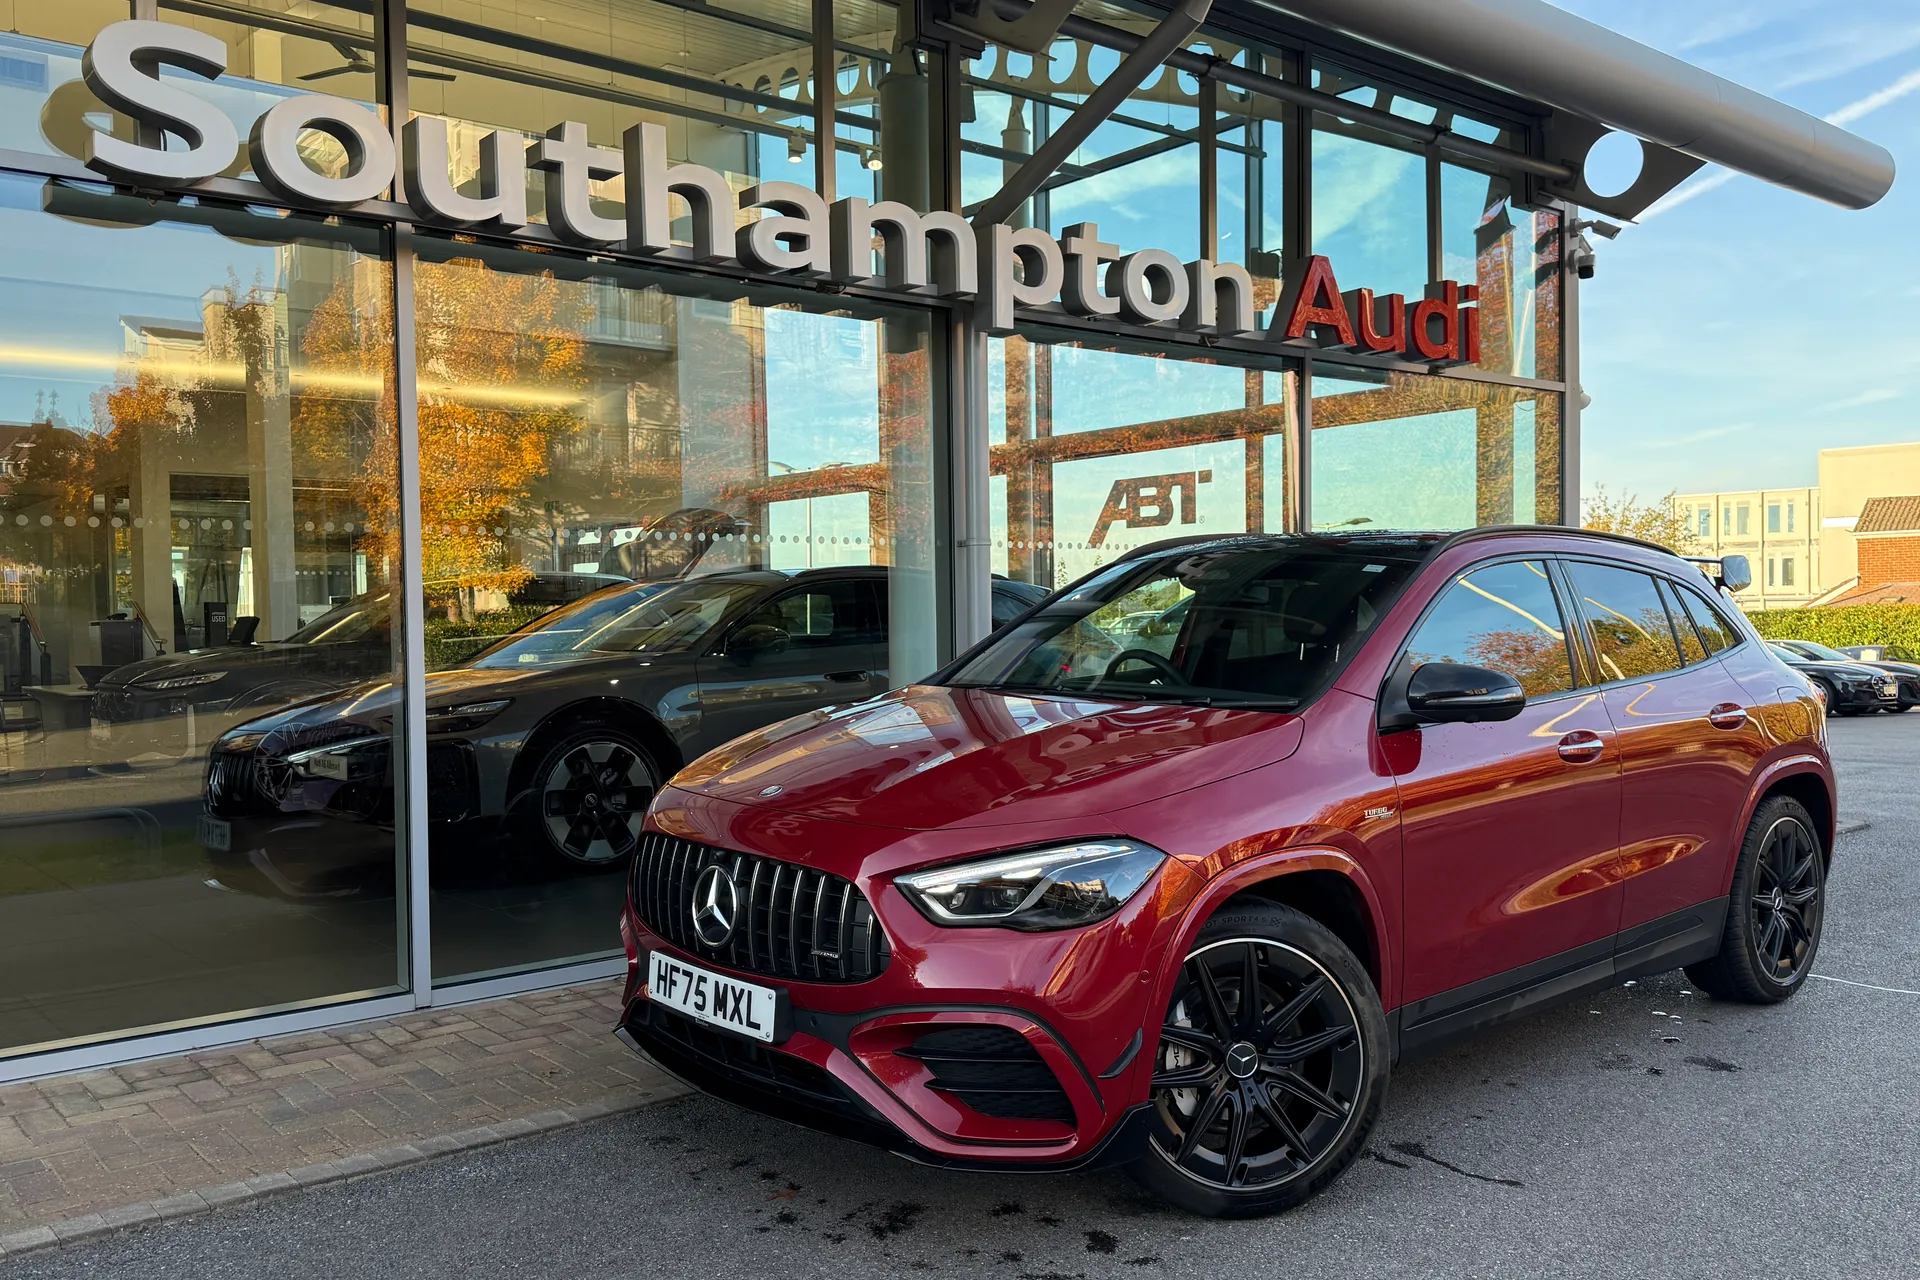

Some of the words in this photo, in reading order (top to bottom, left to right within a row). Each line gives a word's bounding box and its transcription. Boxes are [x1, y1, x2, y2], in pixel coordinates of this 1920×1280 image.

[82, 20, 1255, 331] Southampton
[1283, 255, 1481, 364] Audi
[1085, 469, 1212, 549] ABT
[1221, 915, 1252, 925] SPORT
[656, 959, 708, 1012] HF75
[713, 980, 761, 1031] MXL
